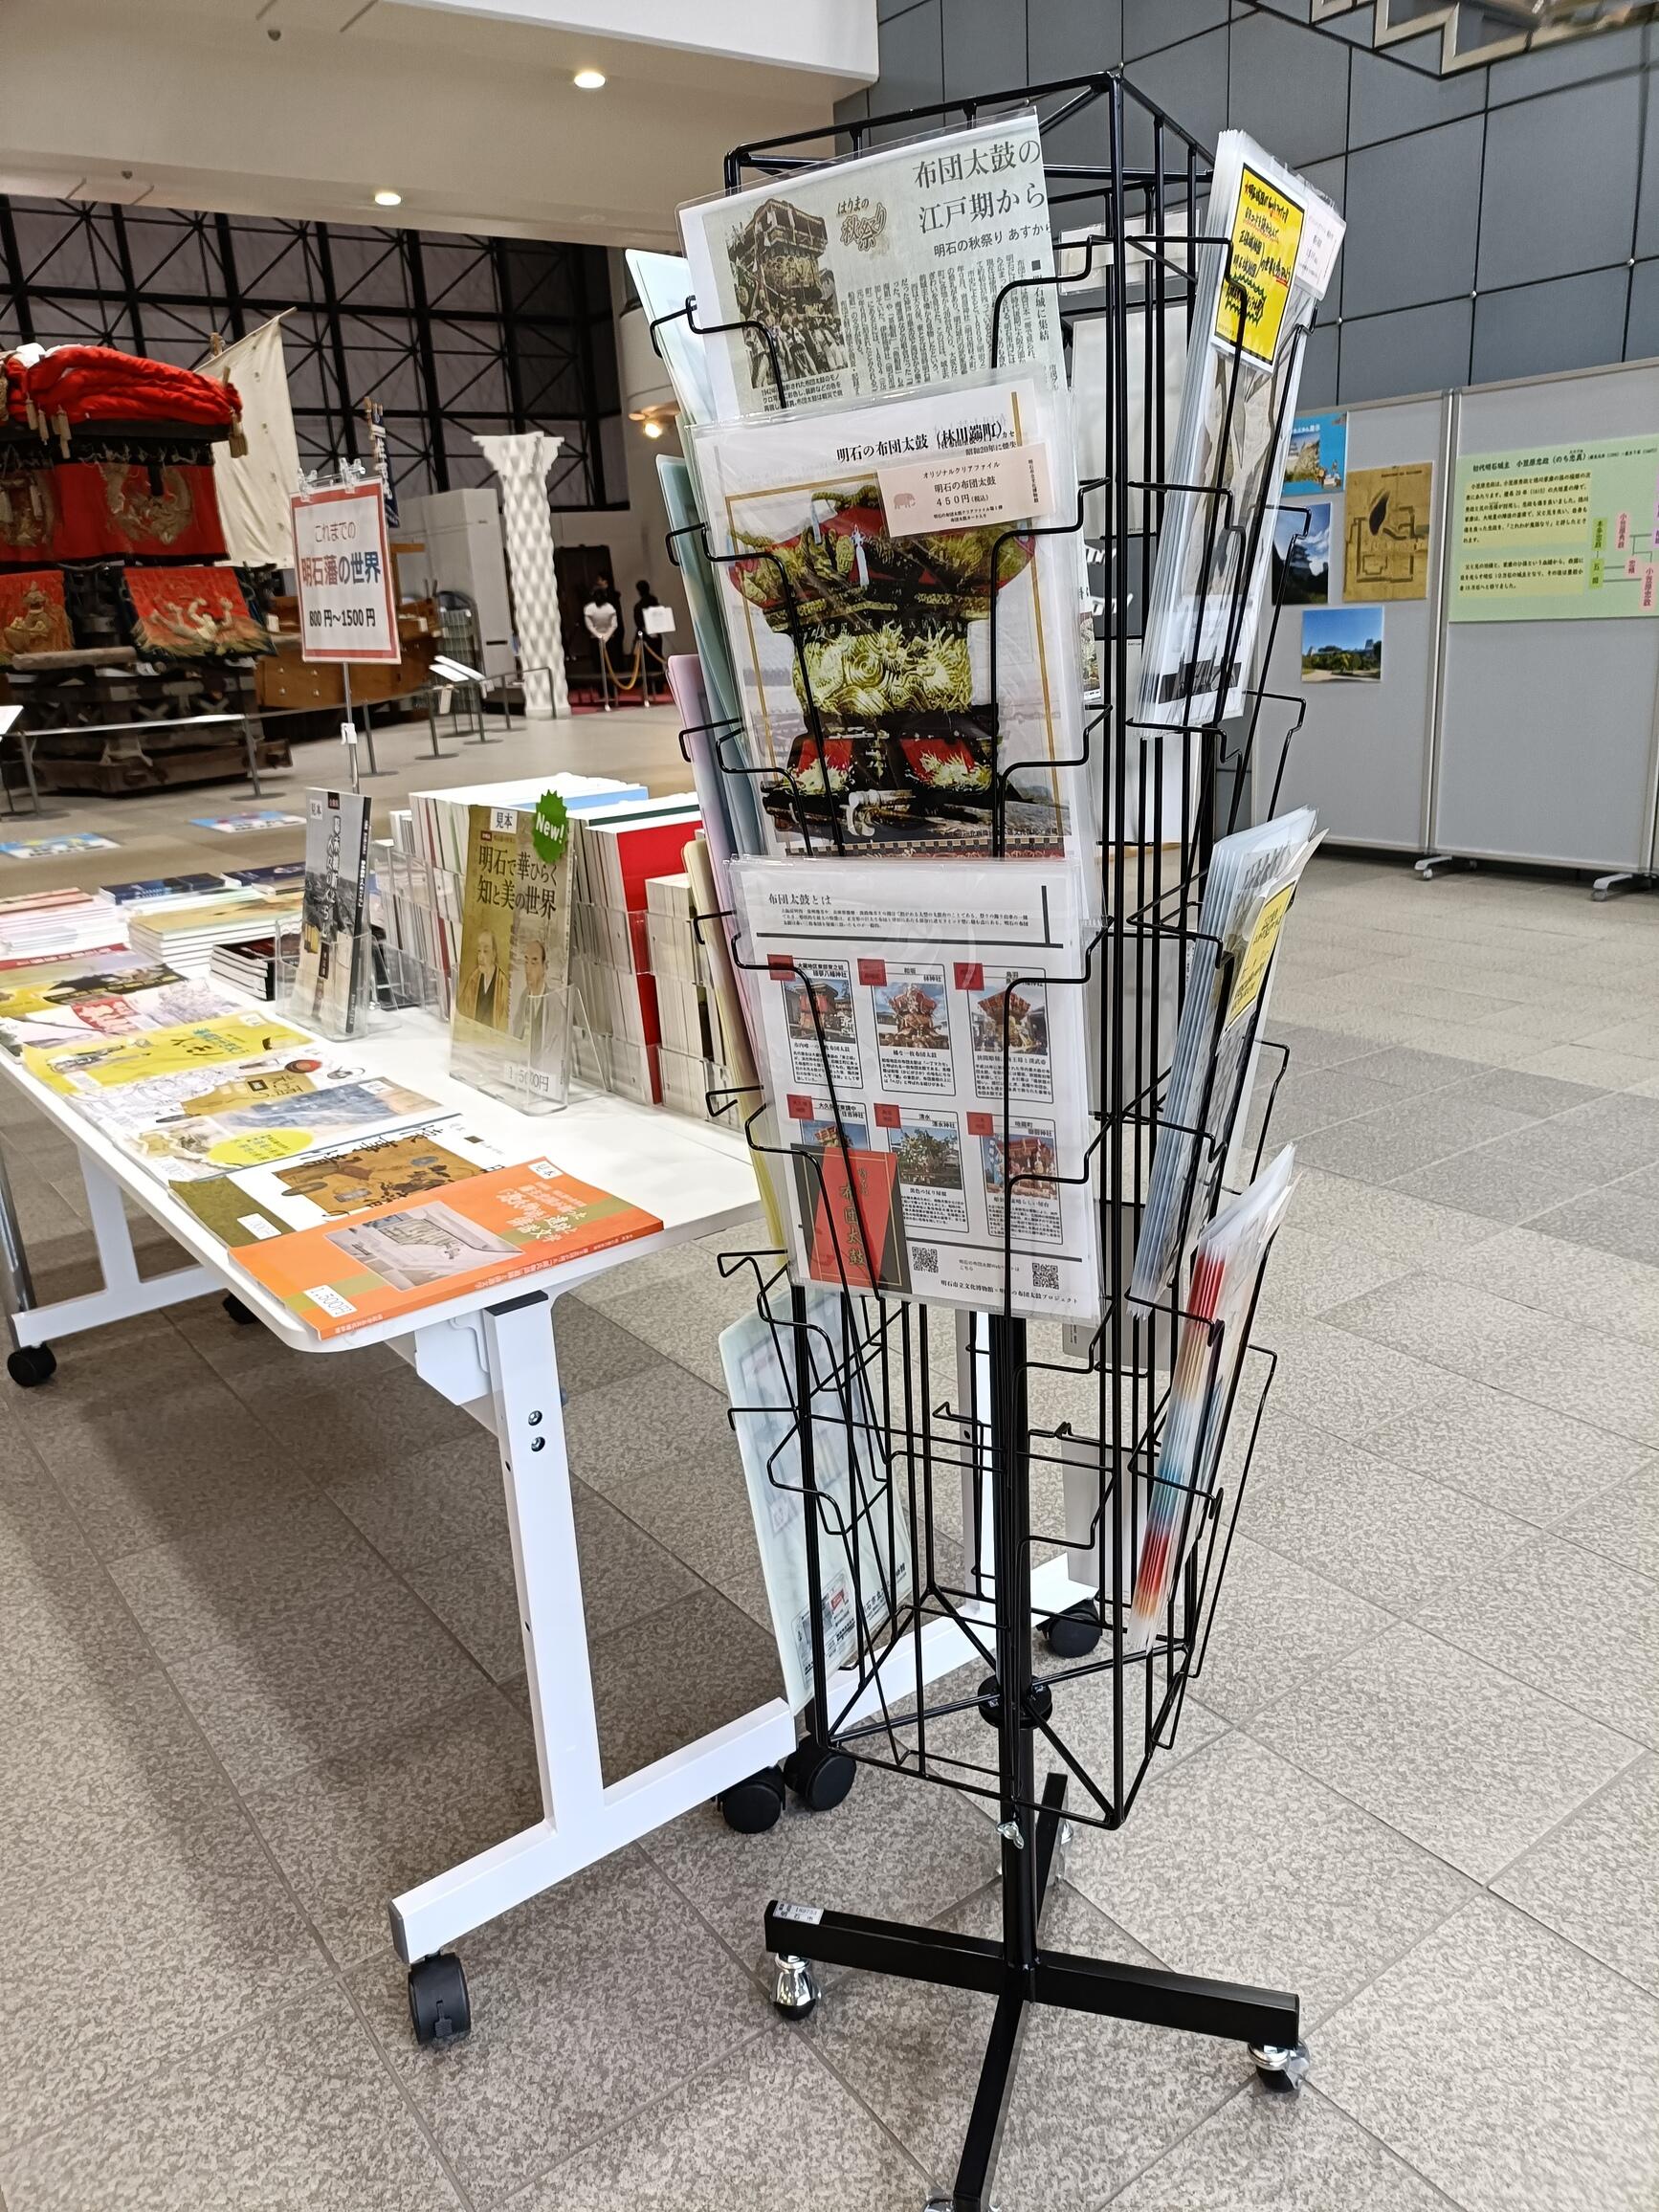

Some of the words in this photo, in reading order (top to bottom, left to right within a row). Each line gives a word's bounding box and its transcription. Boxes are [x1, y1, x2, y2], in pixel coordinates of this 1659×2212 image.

[913, 141, 1040, 188] 布団太鼓の
[837, 196, 869, 214] はりまの
[919, 183, 1044, 233] 江戸期から
[841, 202, 887, 251] 秋祭り
[934, 231, 1003, 257] 明石の秋祭り
[1032, 275, 1050, 343] 石城に集結
[922, 461, 1001, 479] オリジナルクリアファイル
[934, 476, 997, 494] 明石の布団太鼓
[314, 521, 357, 542] これまでの
[300, 551, 381, 587] 明石藩の世界
[496, 811, 514, 830] 見本
[536, 811, 565, 845] New!
[478, 845, 558, 887] 明石で華ひらく
[476, 874, 557, 920] 知と美の世界
[768, 893, 832, 907] 布団太鼓とは
[839, 1183, 865, 1265] 布団太鼓
